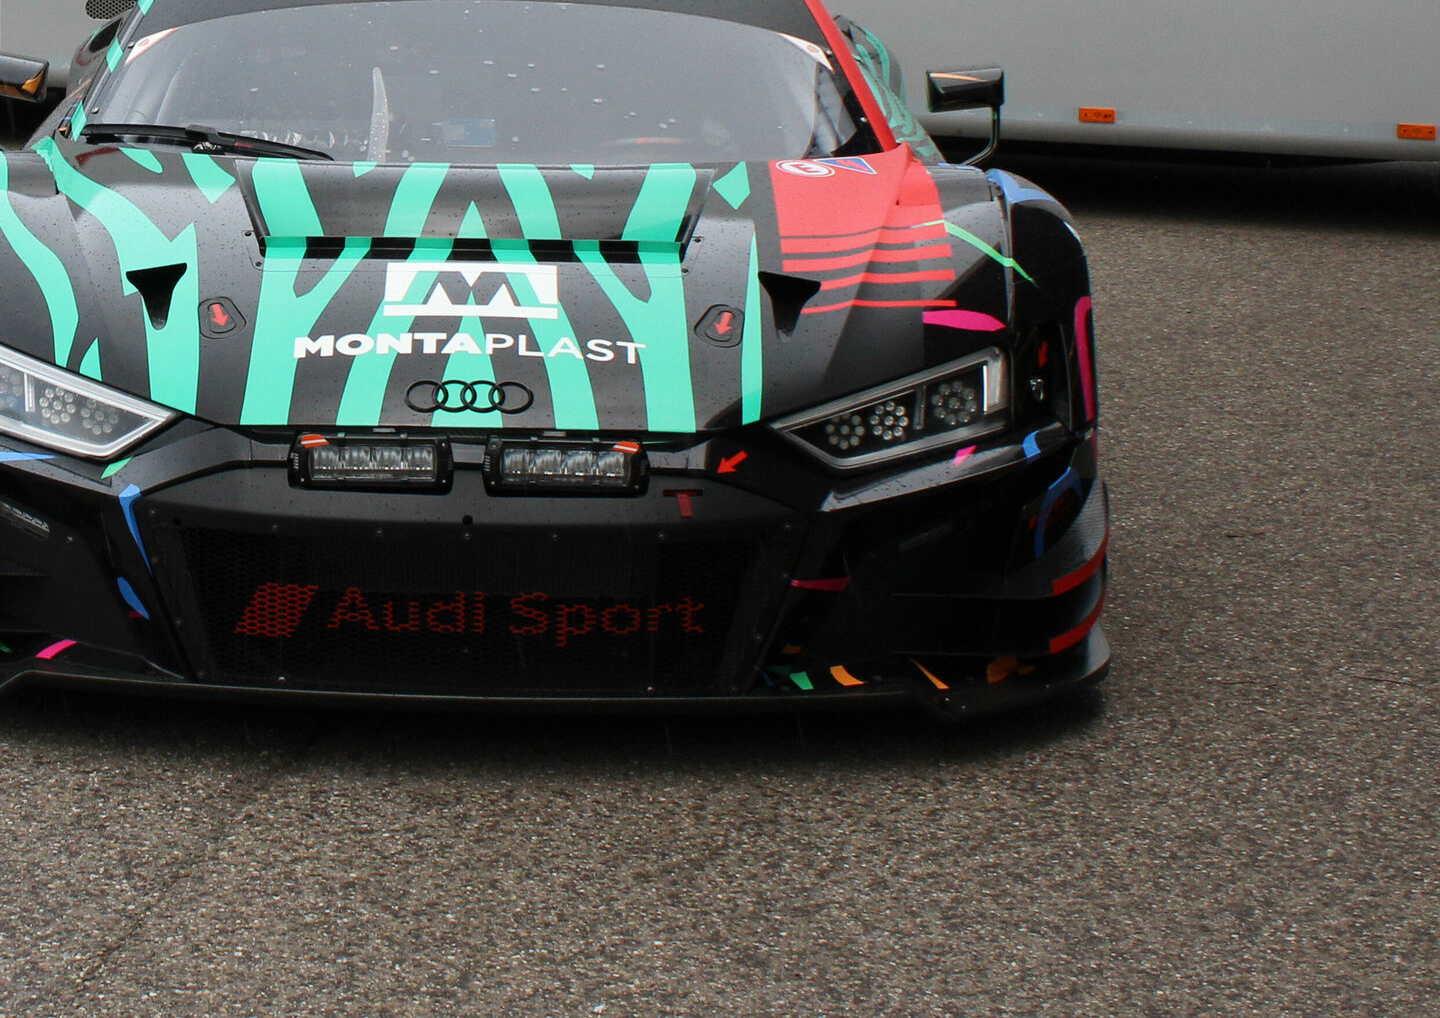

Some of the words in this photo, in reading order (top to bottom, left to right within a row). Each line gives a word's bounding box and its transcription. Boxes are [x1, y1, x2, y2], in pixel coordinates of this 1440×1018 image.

[292, 331, 647, 365] MONTAPLAST
[327, 586, 485, 631] Audi
[509, 590, 705, 647] Sport
